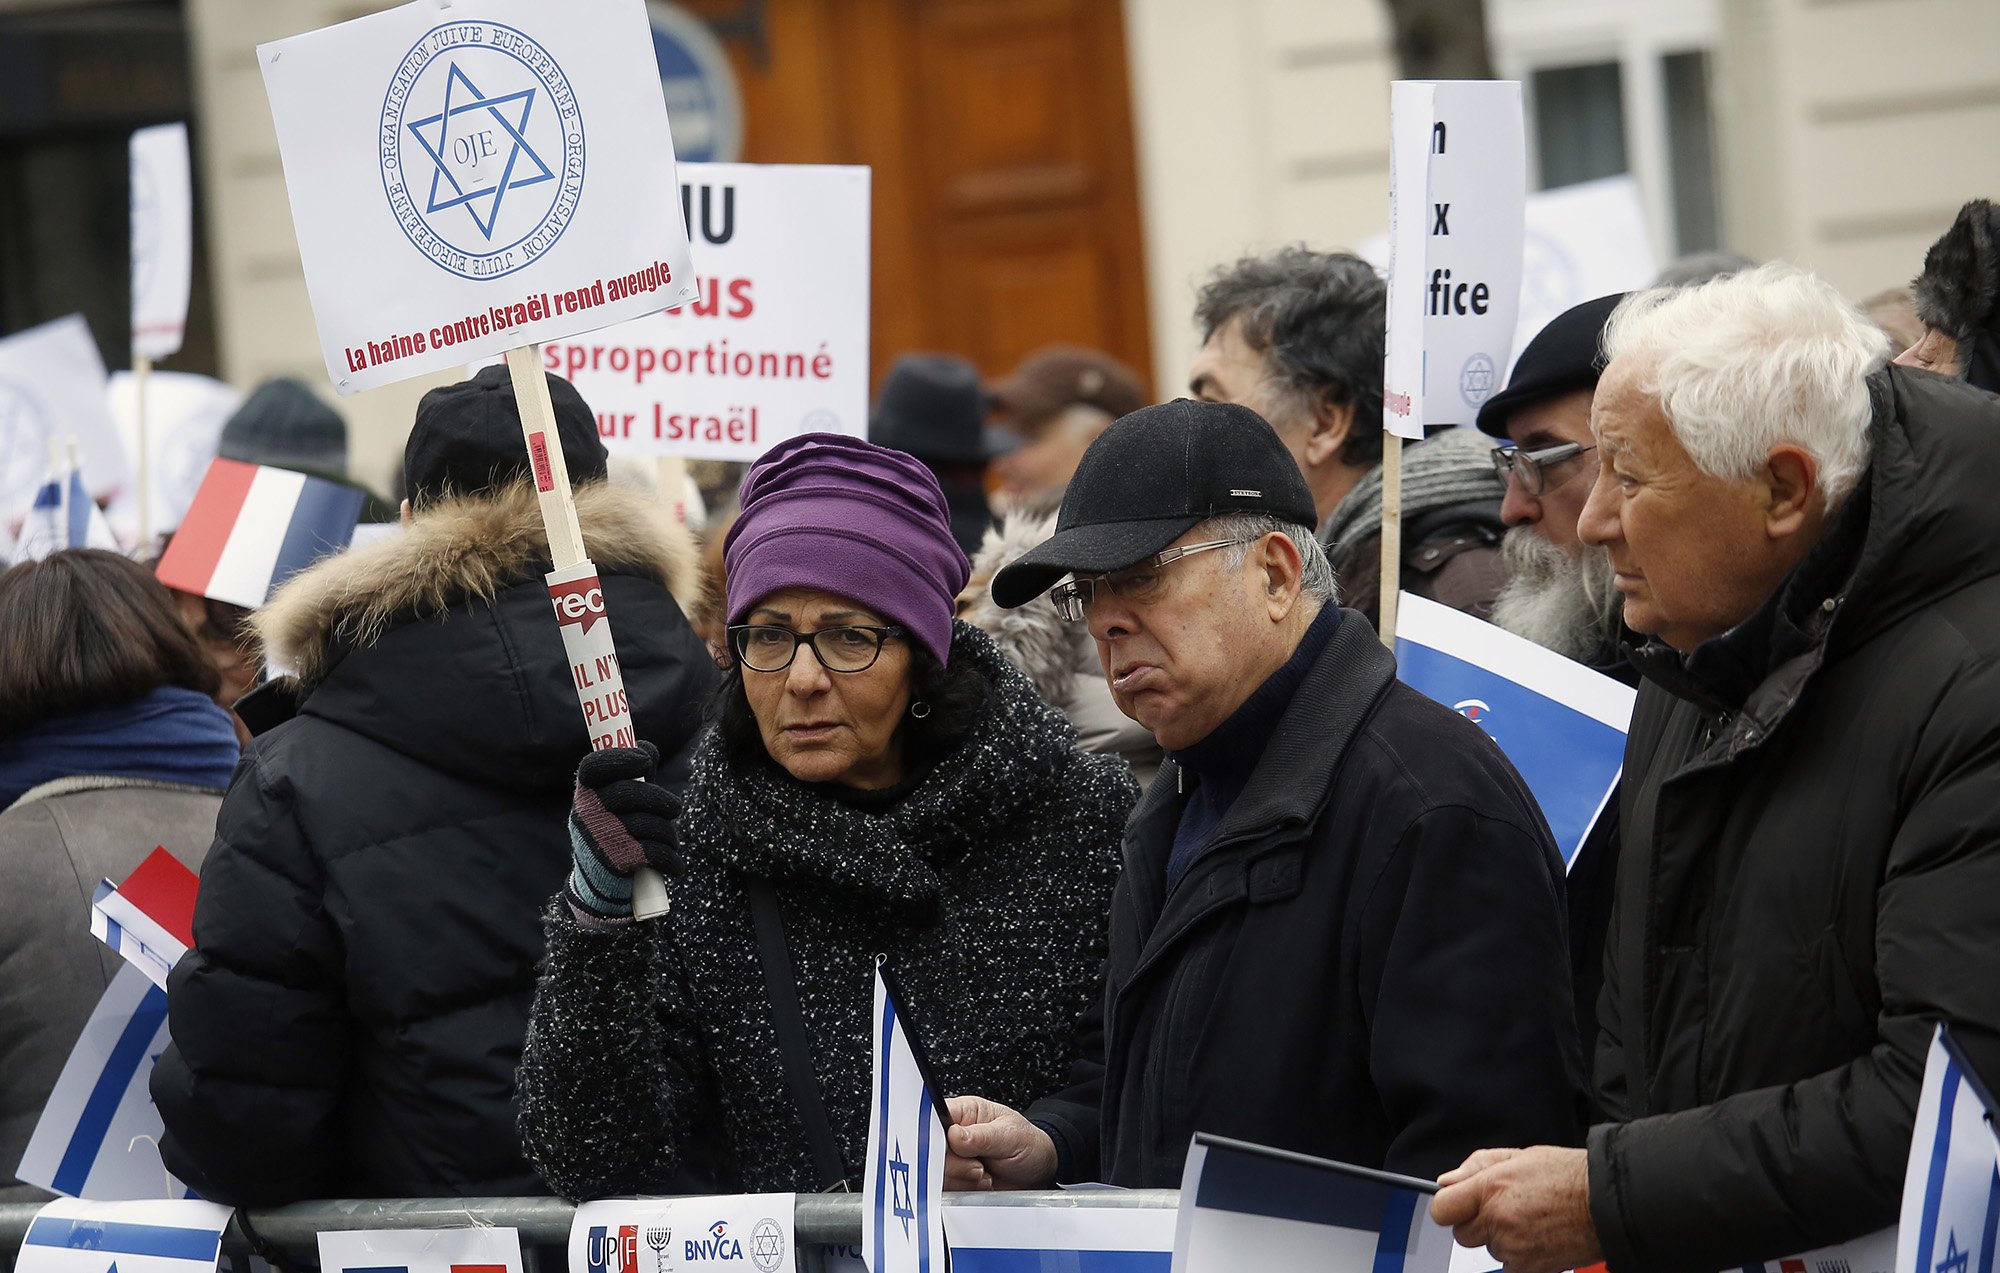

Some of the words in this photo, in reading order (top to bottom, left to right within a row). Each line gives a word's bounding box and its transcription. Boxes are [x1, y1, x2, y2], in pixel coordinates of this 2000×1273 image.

[431, 26, 482, 50] JUIVE
[383, 43, 430, 169] ORGANISATION
[453, 129, 498, 168] OJE
[522, 133, 582, 260] ORGANISATION
[1432, 203, 1450, 236] x
[472, 252, 514, 275] JUIVE
[664, 276, 755, 318] us
[344, 347, 368, 373] La
[367, 331, 427, 366] haine
[430, 315, 490, 350] contre
[489, 293, 551, 331] Israël
[554, 280, 605, 315] rend
[607, 260, 672, 302] aveugle
[544, 340, 832, 384] sproportionné
[595, 412, 636, 439] ur
[653, 403, 759, 443] Israël
[551, 587, 605, 622] rec
[574, 663, 594, 690] IL
[583, 688, 629, 727] PLUS
[588, 1236, 637, 1273] UPJF
[685, 1234, 744, 1261] BNVCA
[823, 1244, 863, 1260] NVC
